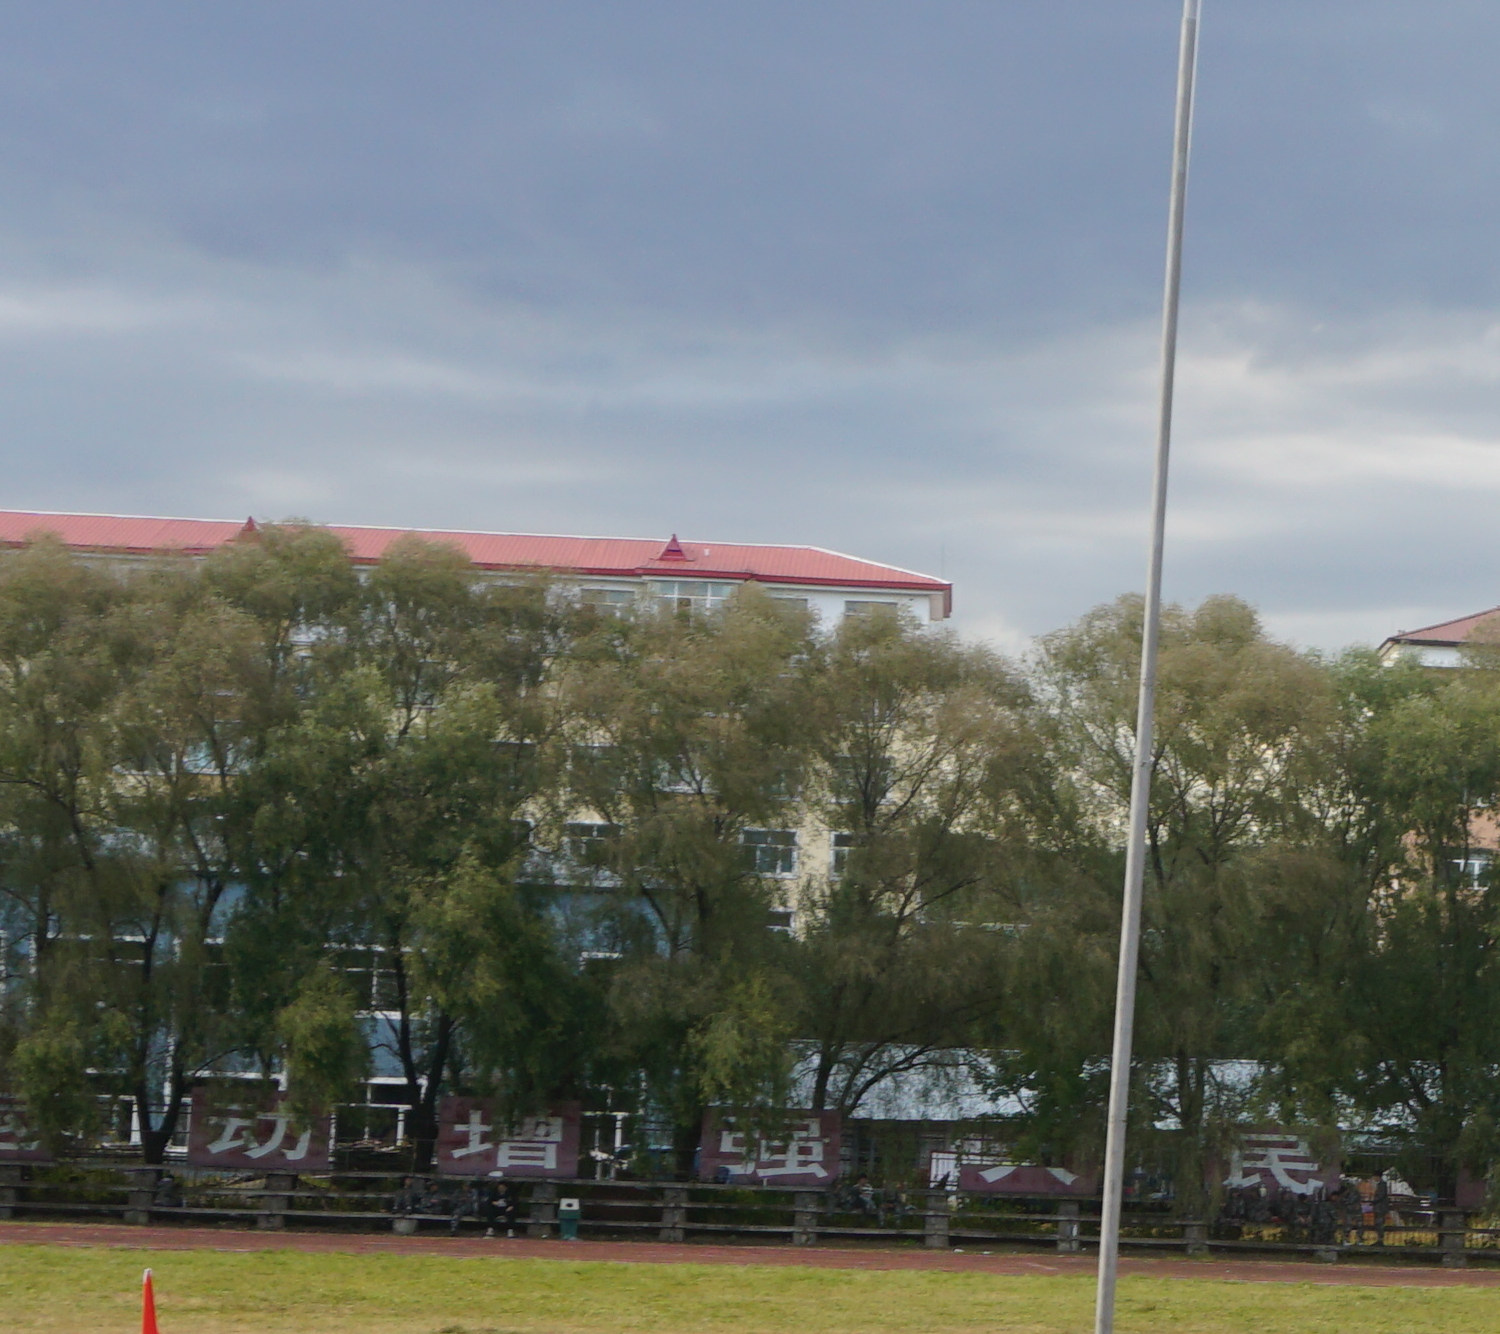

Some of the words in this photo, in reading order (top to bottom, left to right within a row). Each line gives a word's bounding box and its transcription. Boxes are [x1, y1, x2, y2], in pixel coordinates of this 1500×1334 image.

[205, 1101, 312, 1160] 动
[450, 1109, 564, 1170] 增
[719, 1115, 828, 1179] 强
[1221, 1133, 1325, 1196] 民
